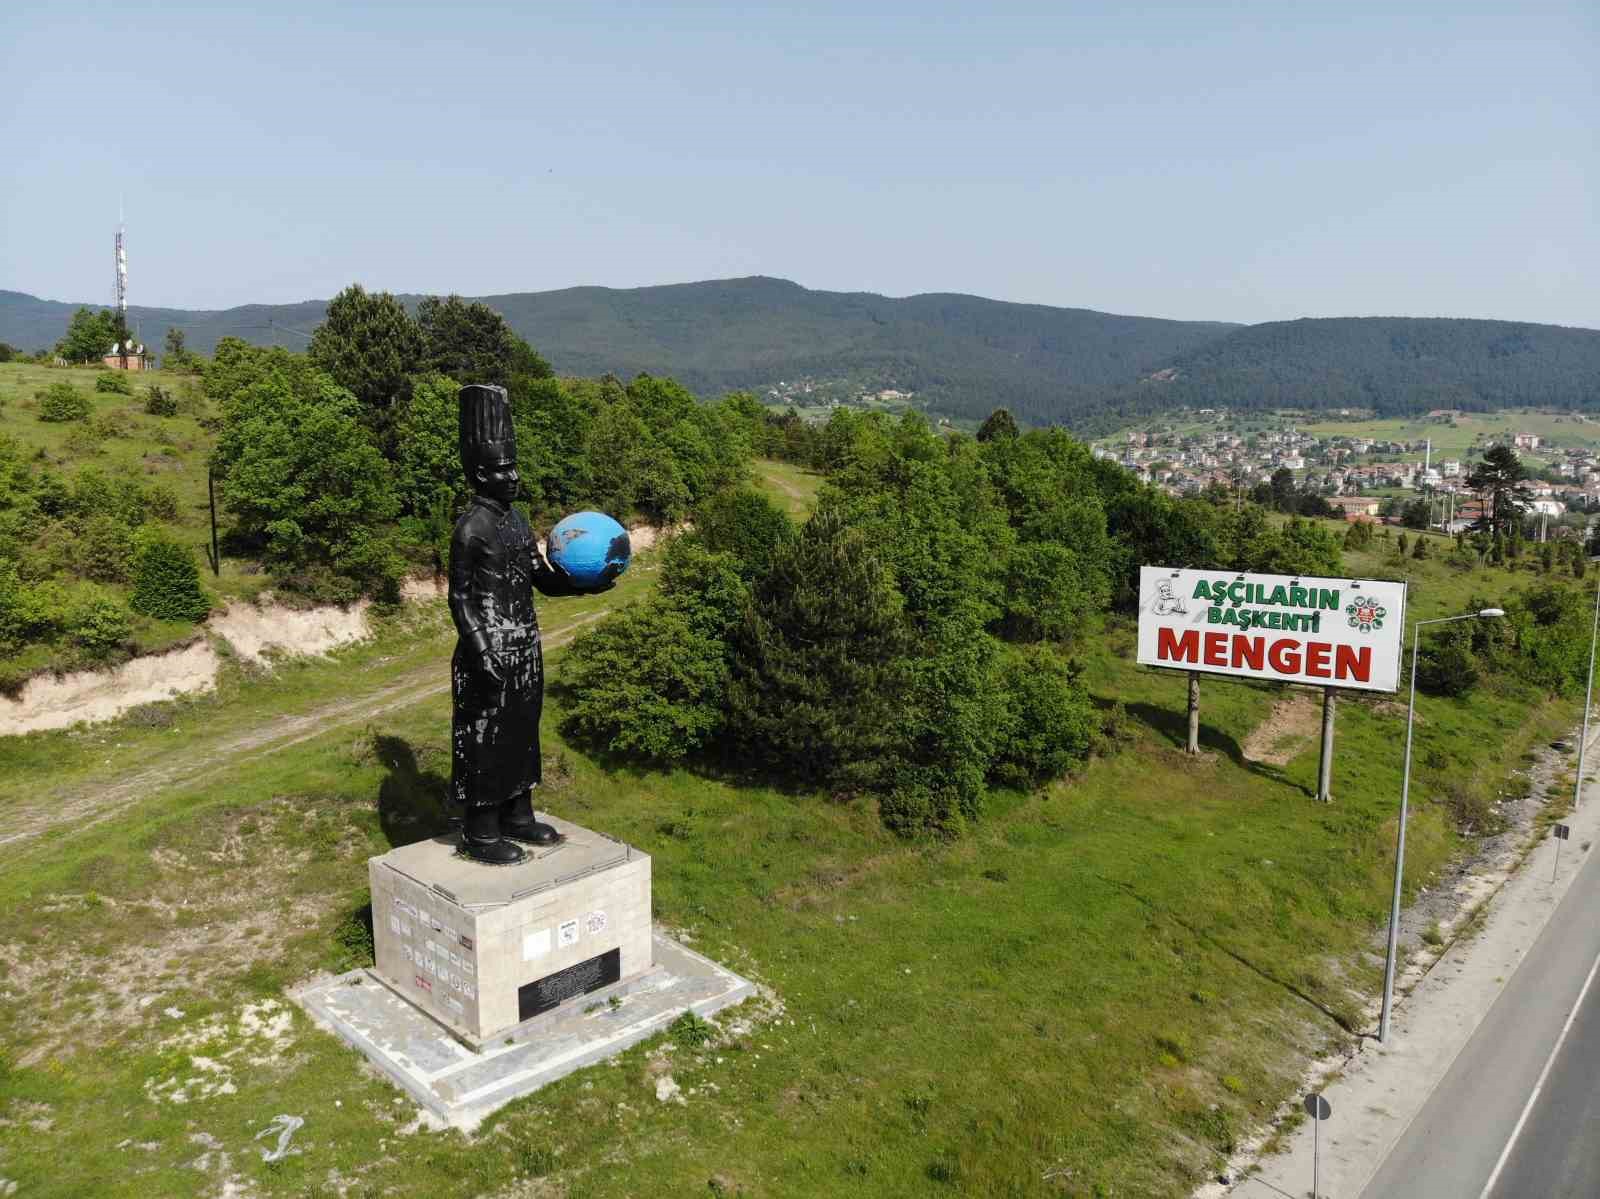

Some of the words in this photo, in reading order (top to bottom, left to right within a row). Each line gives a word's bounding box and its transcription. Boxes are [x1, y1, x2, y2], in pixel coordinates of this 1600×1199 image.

[1192, 579, 1340, 610] AŞÇILARIN
[1207, 607, 1320, 633] BAŞKENTİ
[1158, 627, 1371, 682] MENGEN
